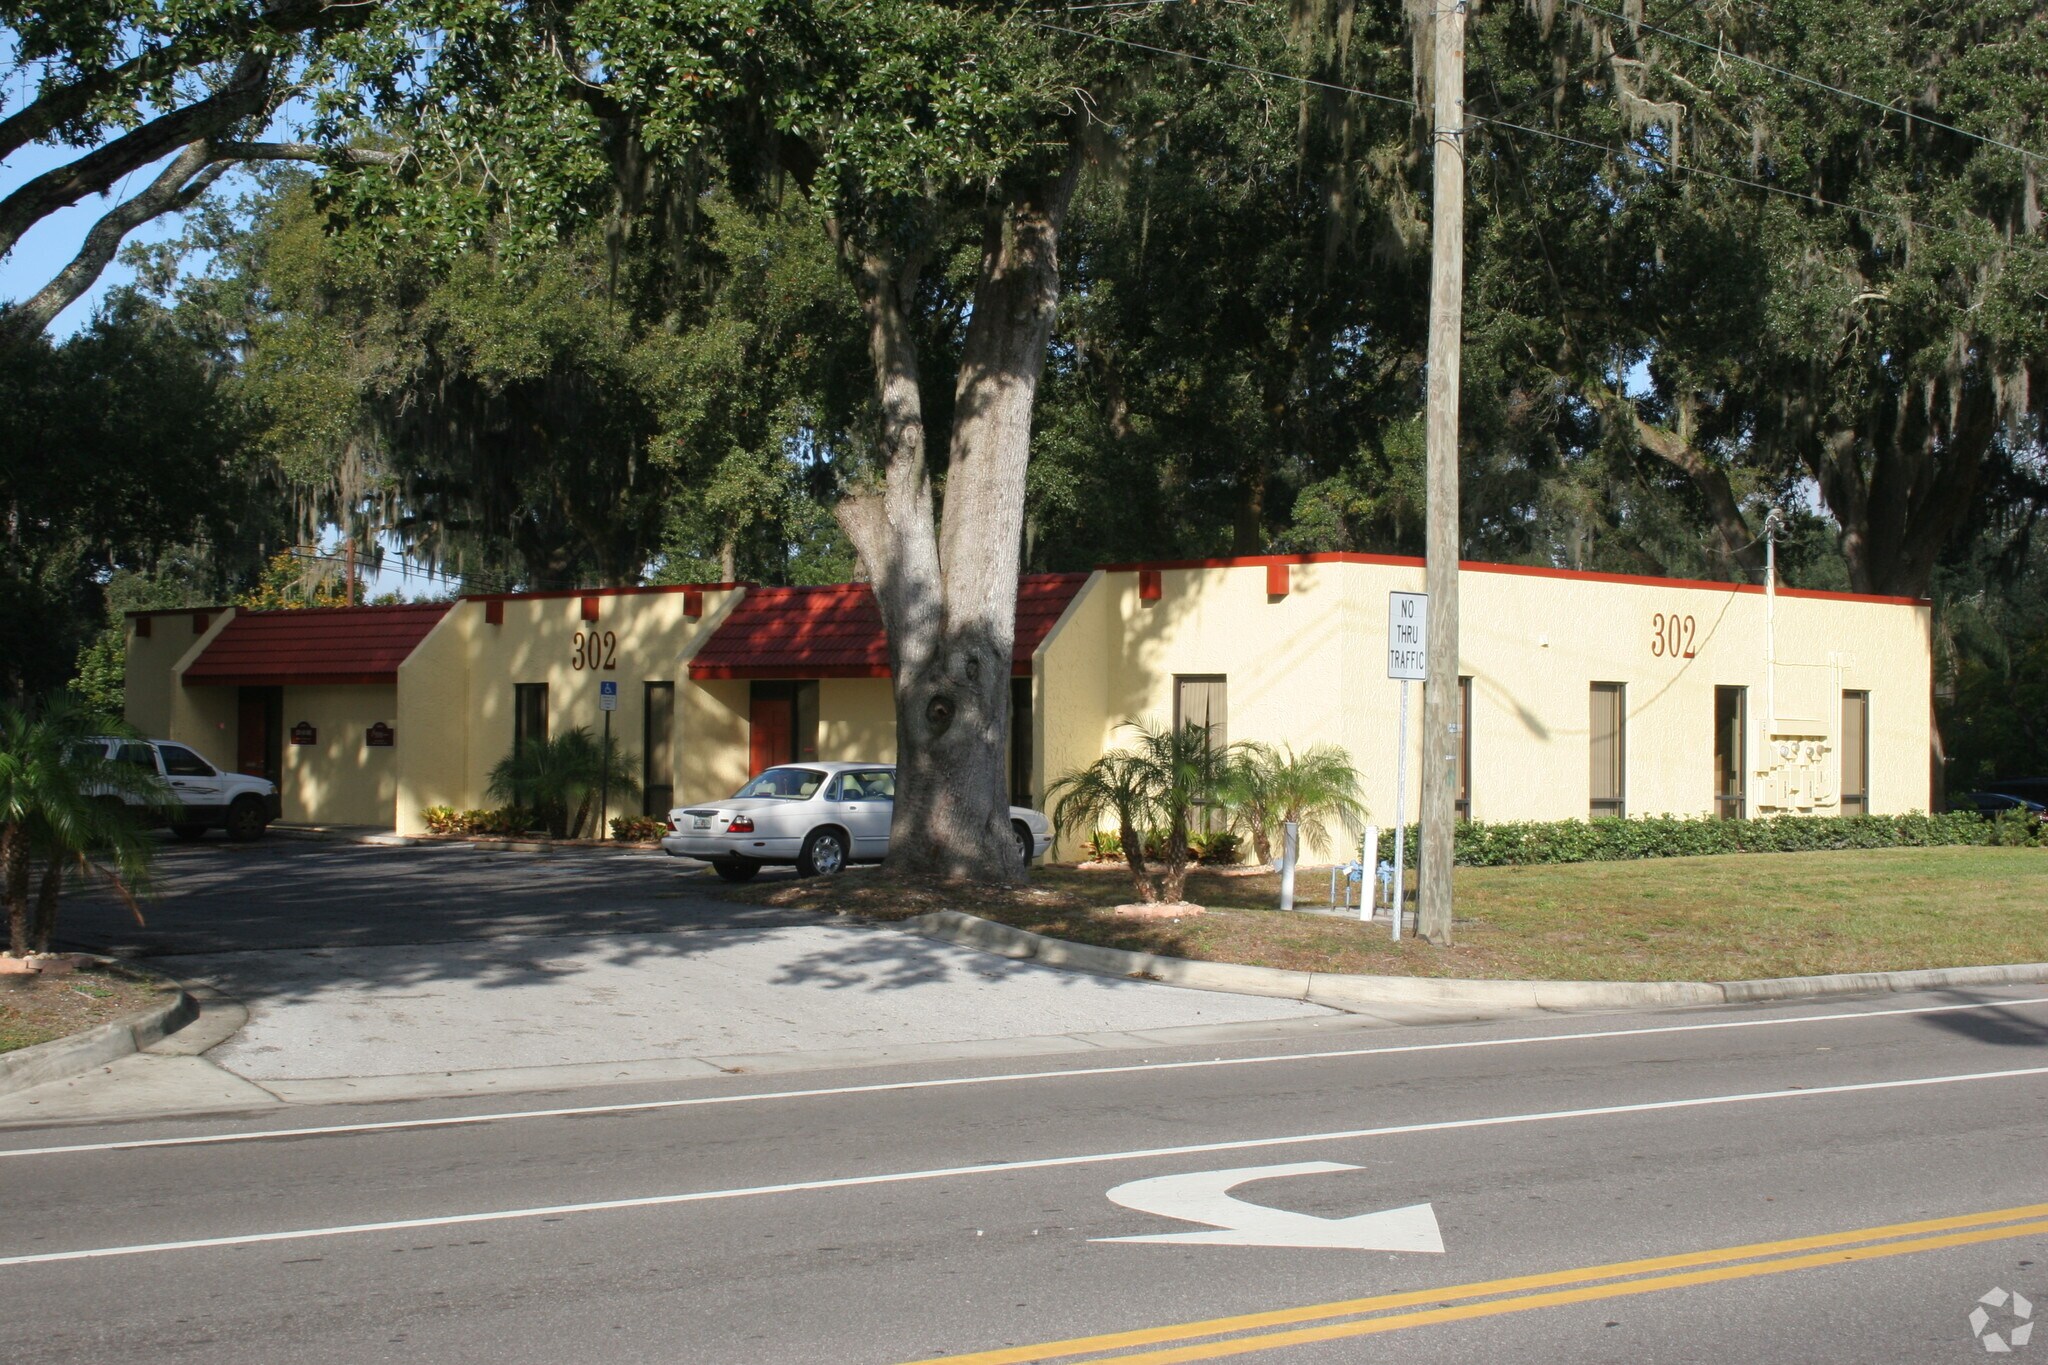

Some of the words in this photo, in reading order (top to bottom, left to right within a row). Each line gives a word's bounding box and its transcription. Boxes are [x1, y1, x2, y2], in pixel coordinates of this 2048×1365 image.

[1401, 599, 1414, 618] NO
[1397, 624, 1418, 644] THRU
[1652, 613, 1696, 659] 302
[572, 630, 616, 671] 302
[1390, 649, 1424, 670] TRAFFIC
